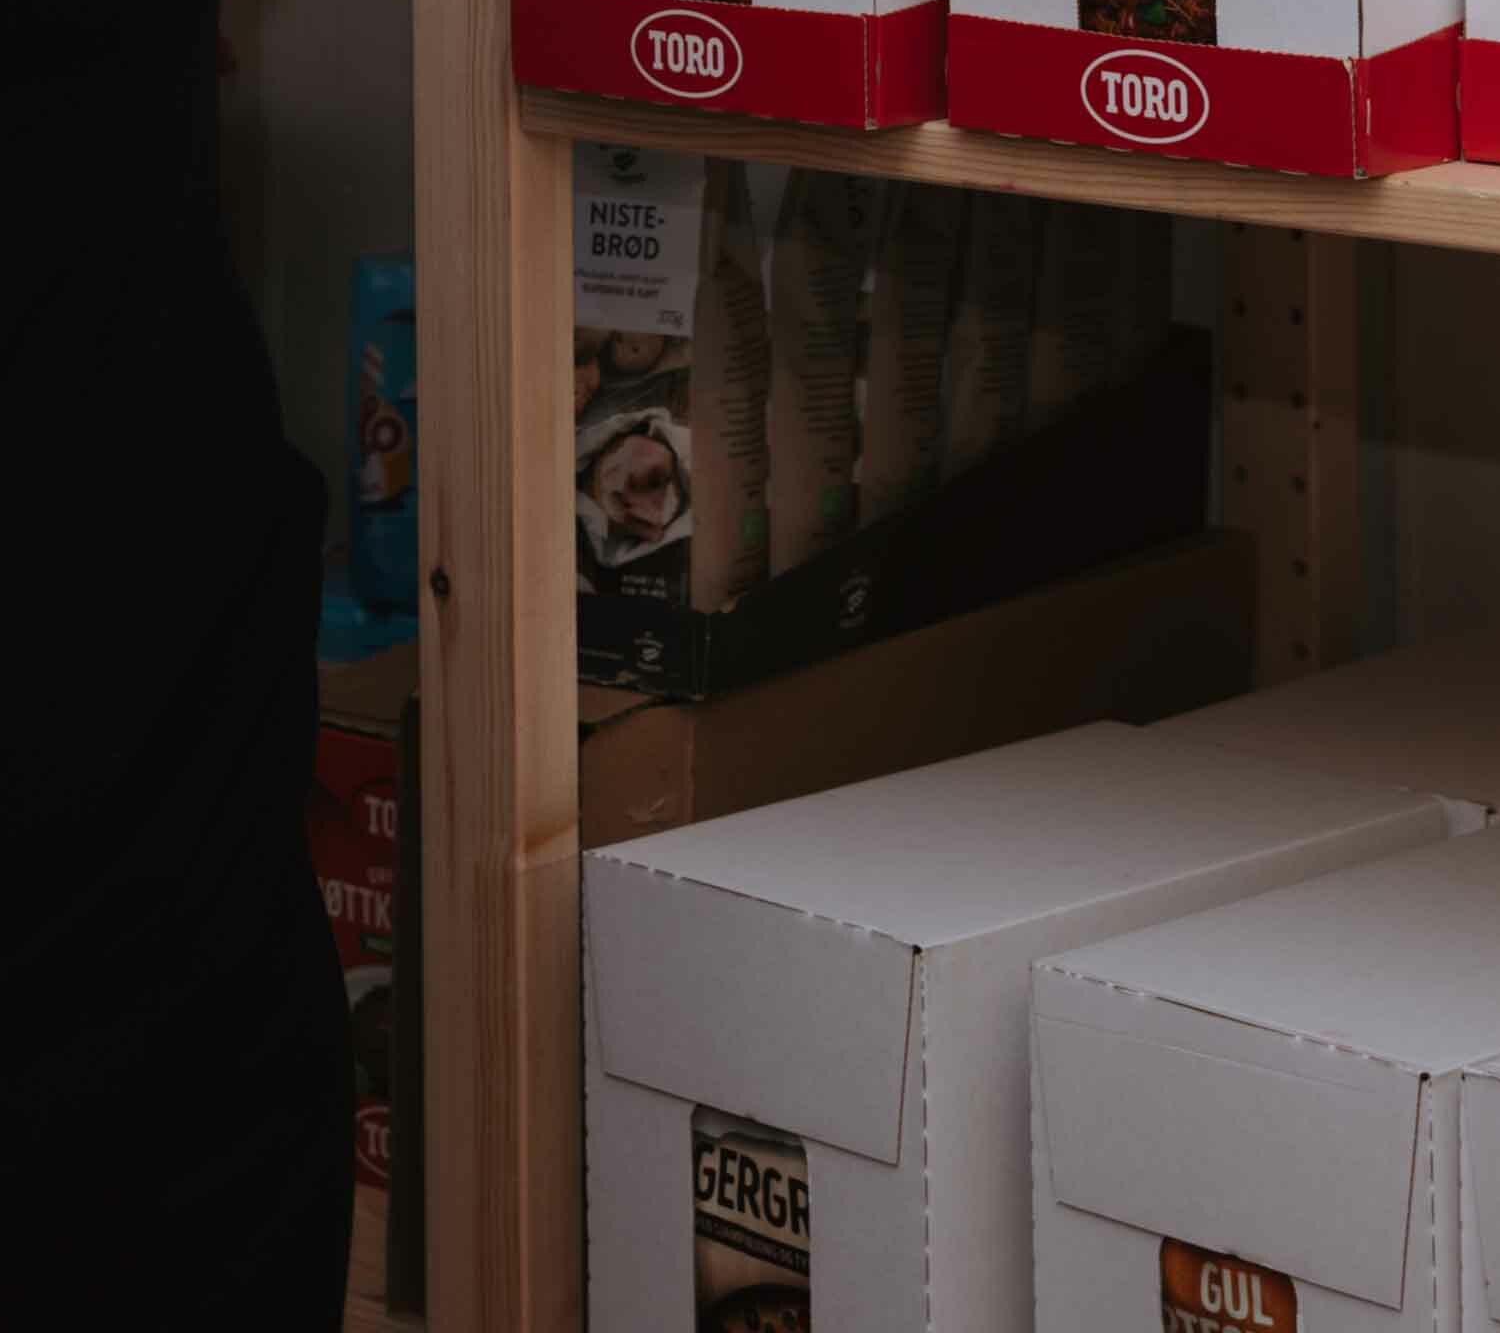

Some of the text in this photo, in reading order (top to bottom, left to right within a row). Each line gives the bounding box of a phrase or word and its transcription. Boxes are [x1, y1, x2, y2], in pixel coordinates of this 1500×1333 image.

[648, 29, 725, 78] TORO
[1100, 68, 1189, 124] TORO
[588, 202, 665, 229] NISTE-
[591, 232, 660, 260] BRØD
[1200, 1260, 1274, 1327] GUL
